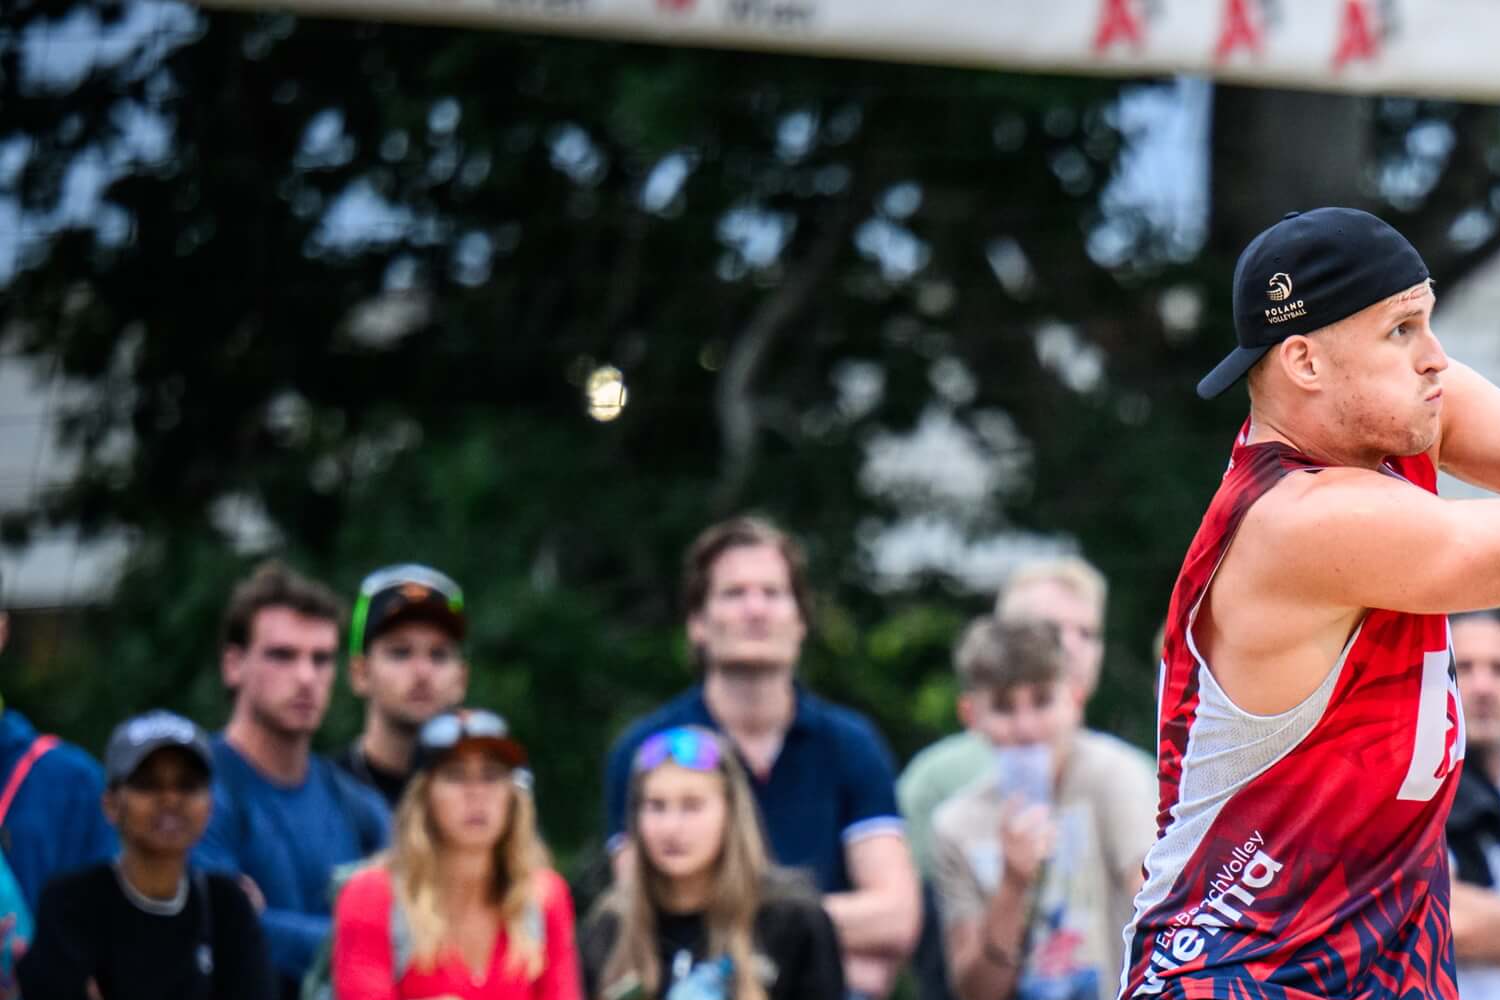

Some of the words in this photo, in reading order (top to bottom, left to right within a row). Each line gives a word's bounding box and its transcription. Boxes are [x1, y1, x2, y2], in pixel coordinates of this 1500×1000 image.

[1264, 299, 1305, 318] POLAND
[1267, 307, 1308, 324] VOLLEYBALL
[1156, 829, 1265, 950] EuBchVolley
